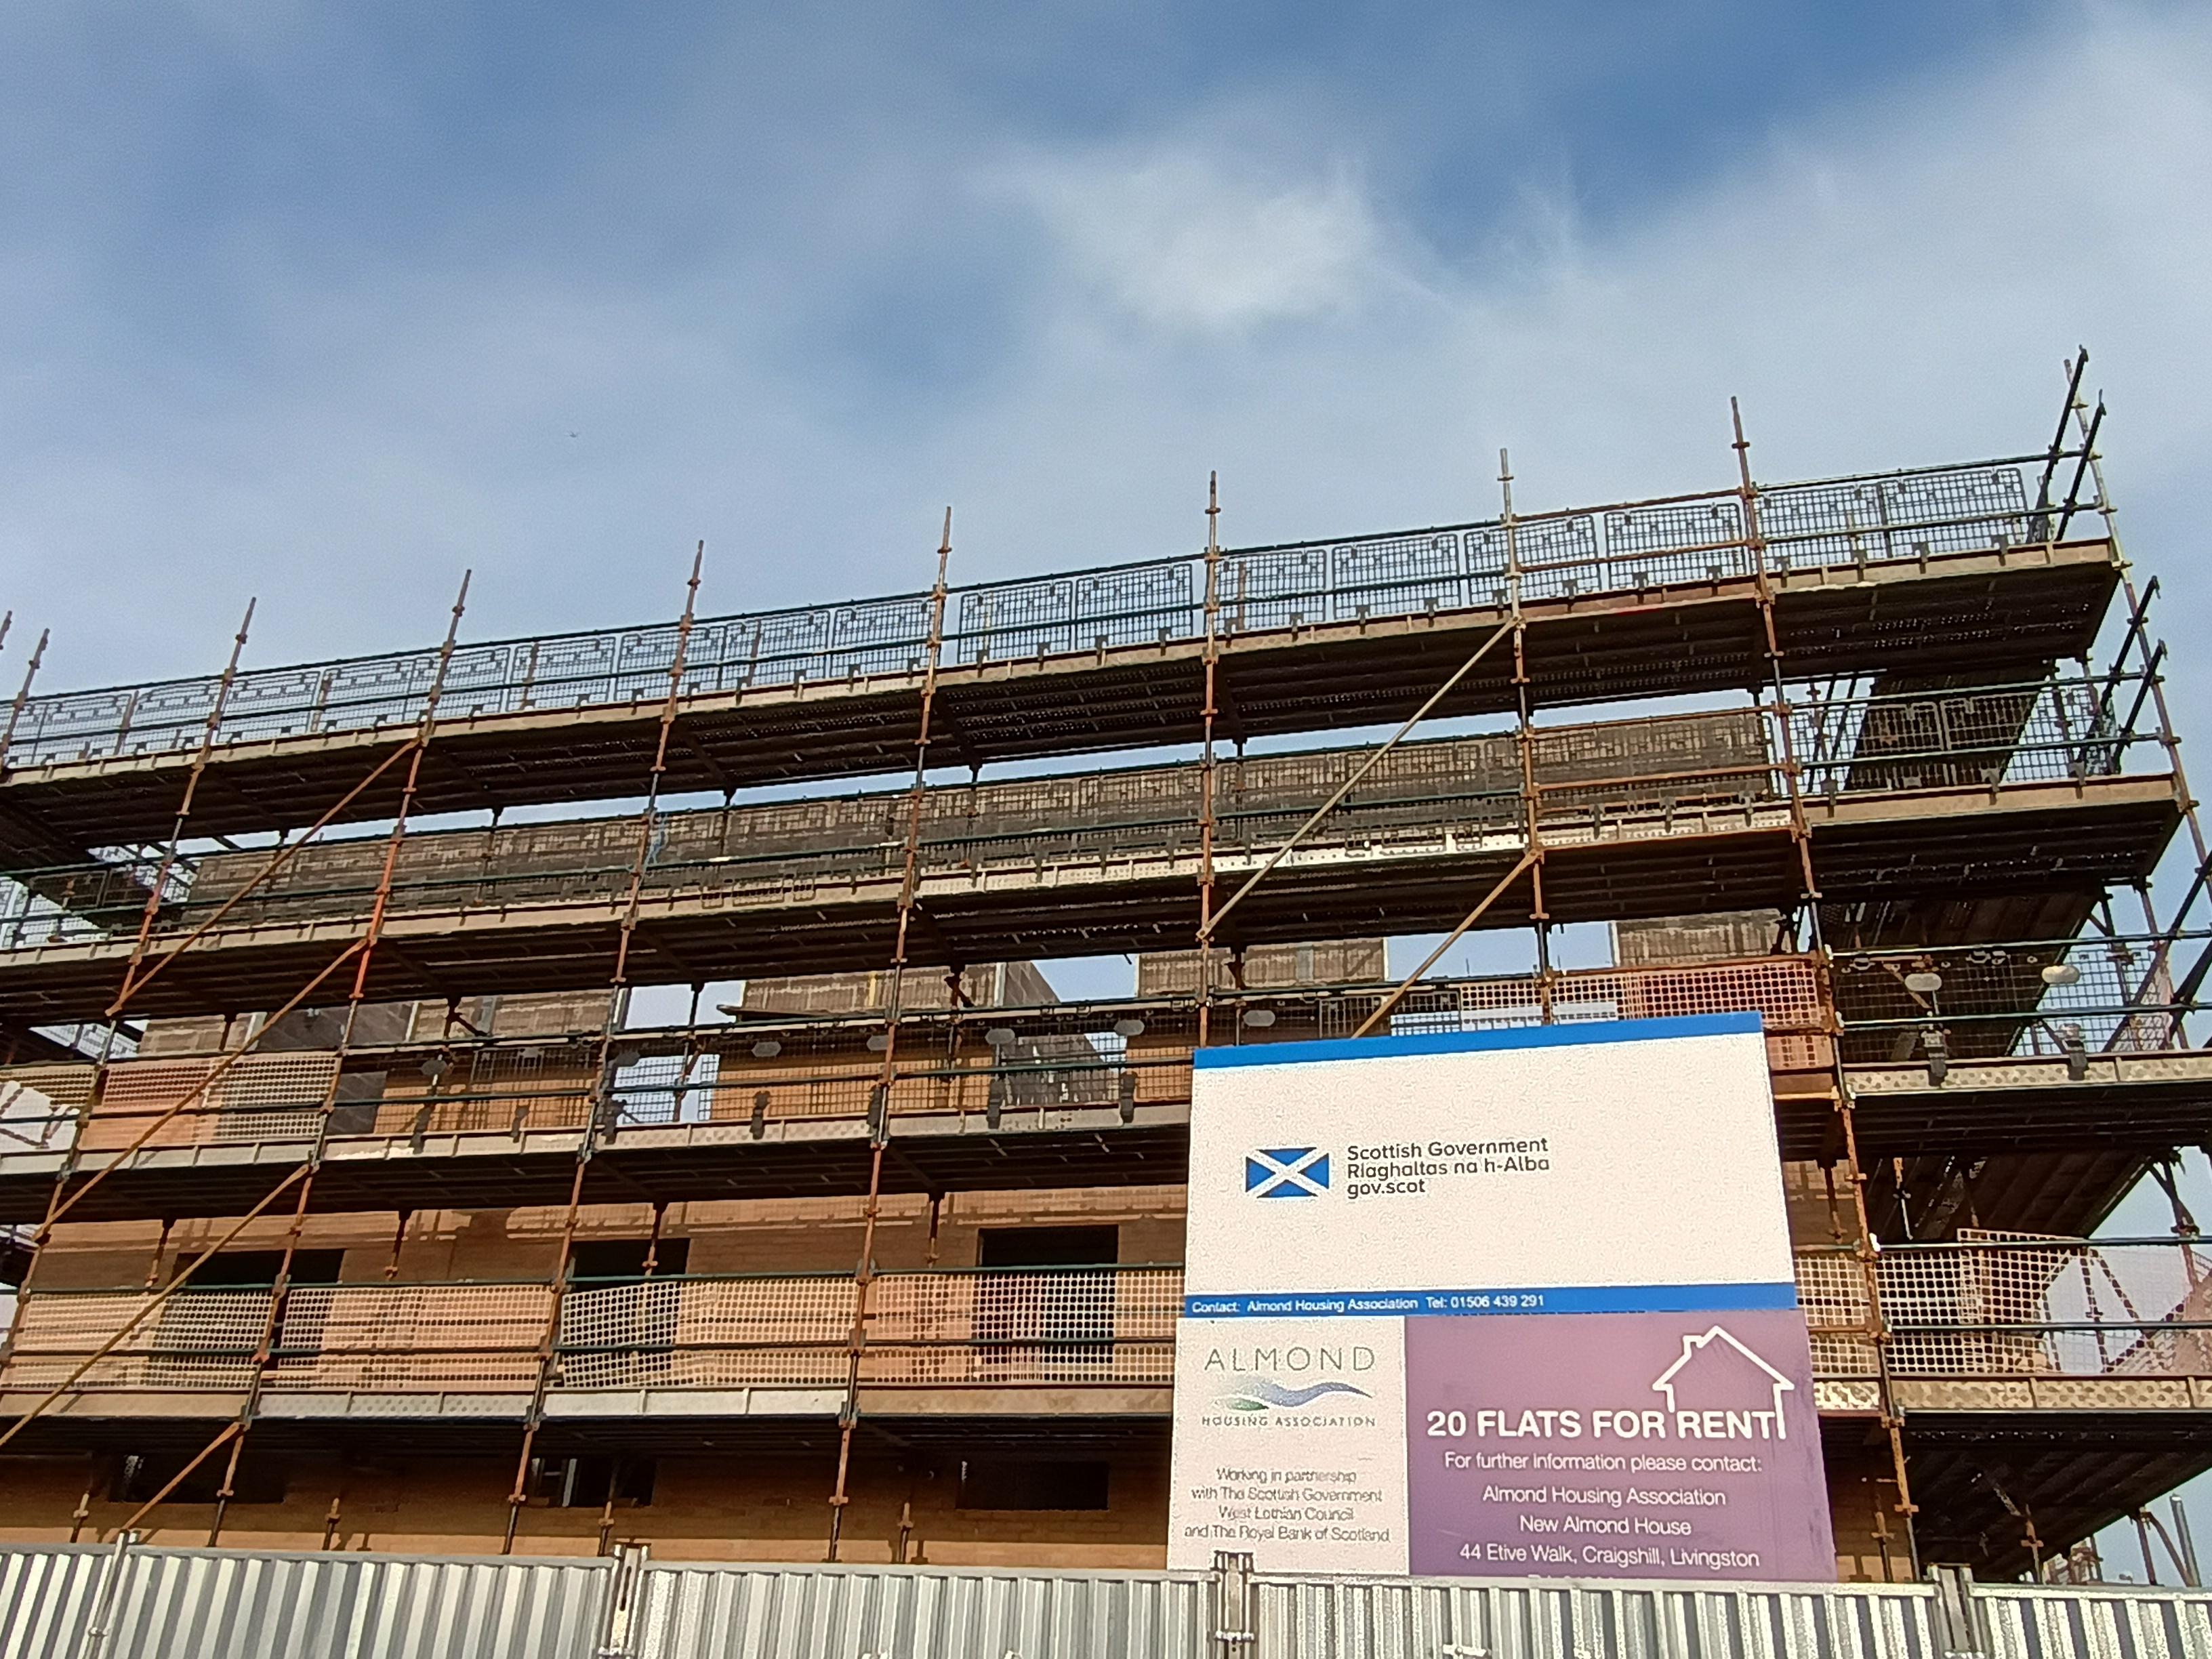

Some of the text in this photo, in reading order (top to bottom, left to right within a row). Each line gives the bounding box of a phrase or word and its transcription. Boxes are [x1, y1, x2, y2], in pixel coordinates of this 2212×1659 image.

[1347, 1138, 1549, 1160] Scottish Government
[1347, 1156, 1550, 1181] Riaghaltas na h-Alba
[1347, 1179, 1426, 1200] gov.scot
[1192, 1294, 1544, 1313] Contact: Almond Housing Association Tel: 01506 439 291
[1204, 1347, 1375, 1371] ALMOND
[1202, 1416, 1376, 1427] HOUSING ASSOCIATION
[1427, 1410, 1776, 1439] 20 FLATS FOR RENT
[1445, 1452, 1762, 1473] For further information please contact:
[1216, 1468, 1357, 1484] Working in partnership
[1191, 1486, 1383, 1502] with The Scottish Government
[1483, 1486, 1726, 1508] Almond Housing Association
[1218, 1504, 1354, 1521] West Lothian Council
[1185, 1525, 1390, 1542] and The Royal Bank of Scotland
[1520, 1515, 1692, 1535] New Almond House
[1460, 1544, 1760, 1570] 44 Etive Walk, Craigshill, Livingston
